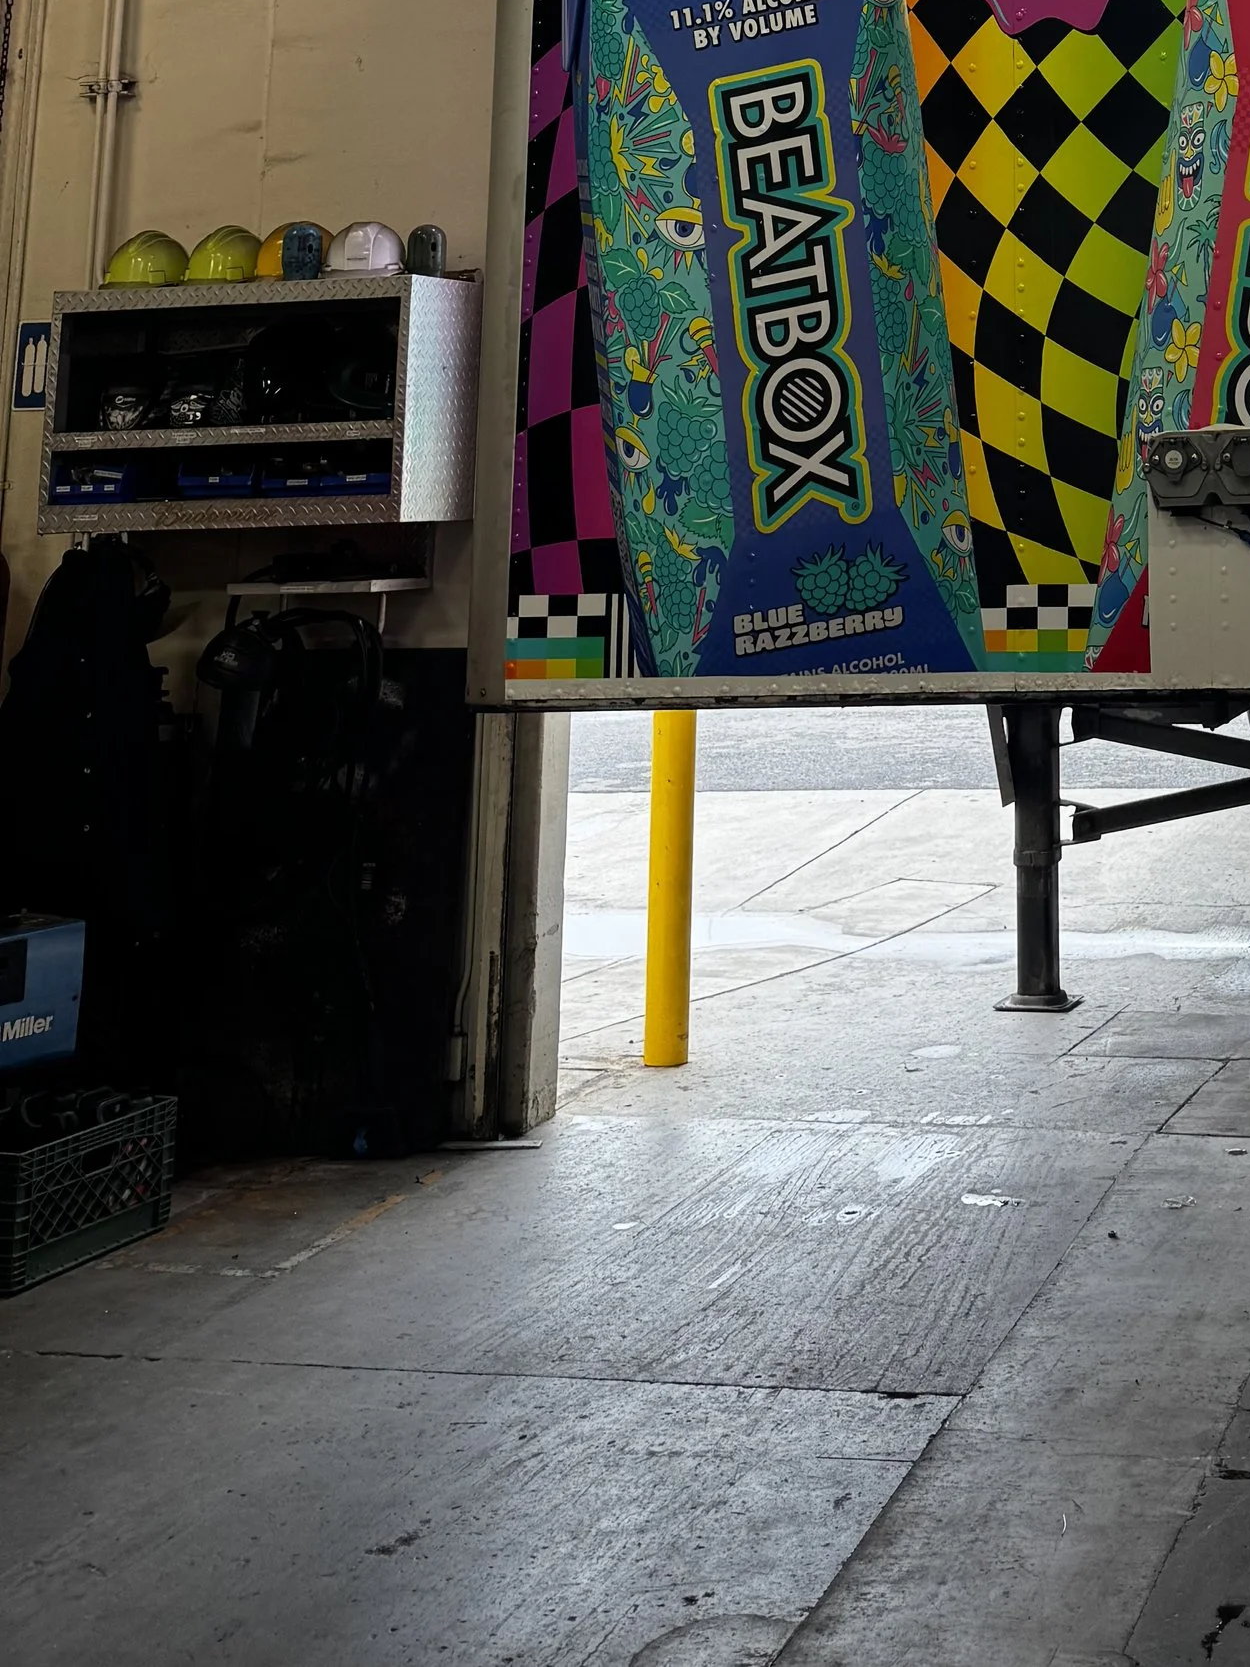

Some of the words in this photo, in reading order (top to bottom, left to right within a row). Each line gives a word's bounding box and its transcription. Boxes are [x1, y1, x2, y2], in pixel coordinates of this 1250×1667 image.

[693, 25, 721, 49] BY
[728, 4, 817, 42] VOLUME
[729, 81, 850, 503] BEATBOX
[733, 603, 804, 634] BLUE
[734, 605, 904, 656] RAZZBERRY
[832, 652, 905, 674] ALCOHOL
[2, 1015, 54, 1042] Miller
